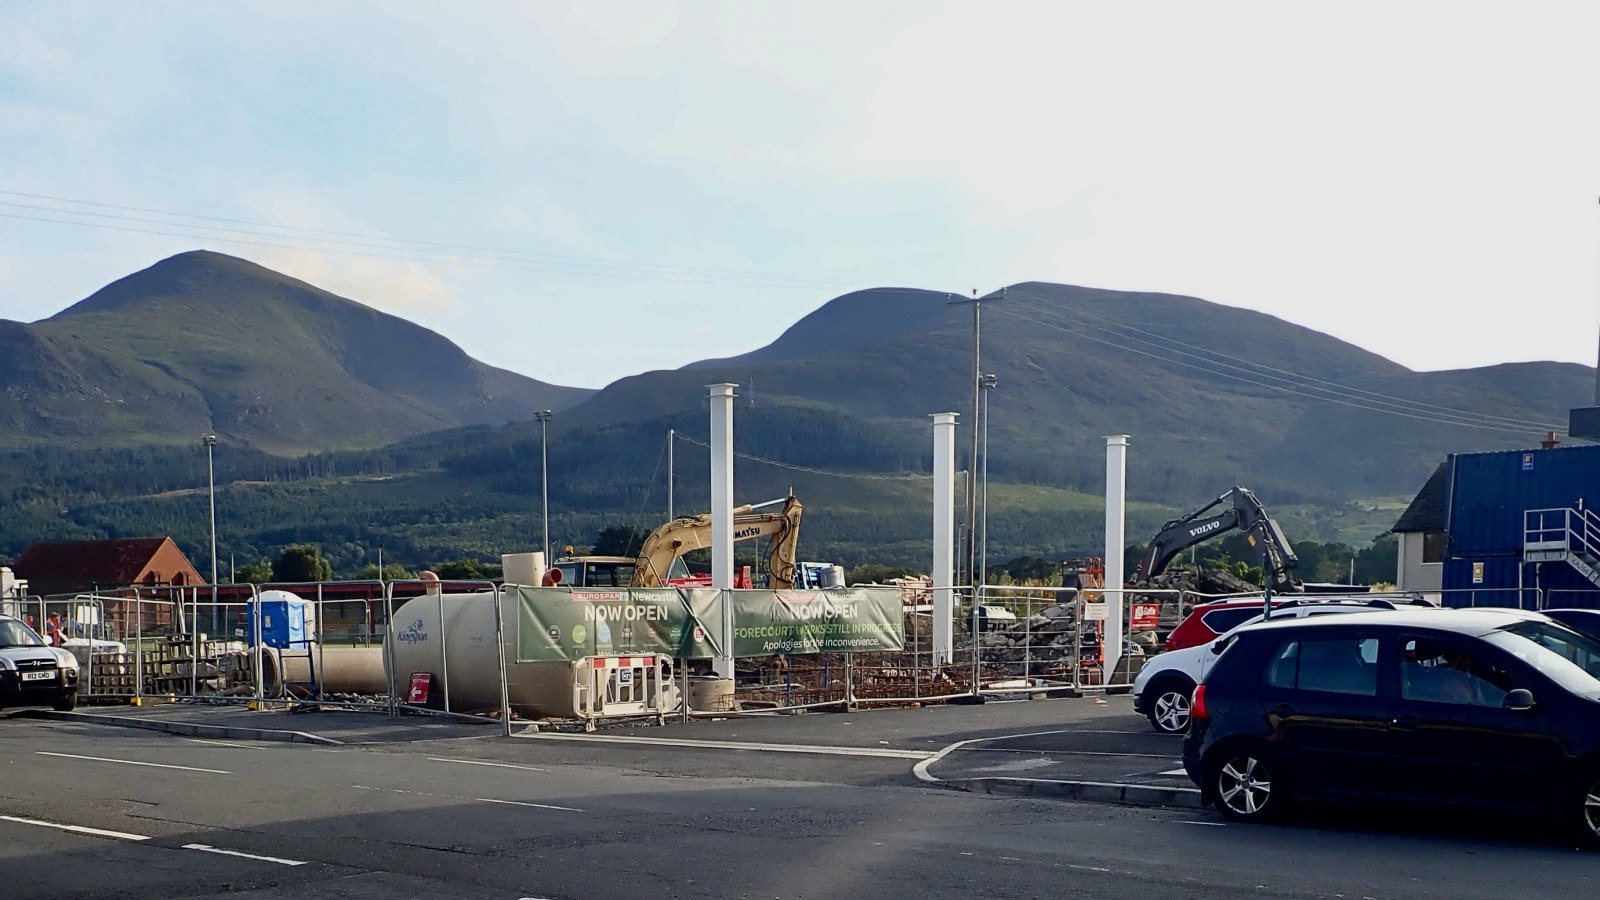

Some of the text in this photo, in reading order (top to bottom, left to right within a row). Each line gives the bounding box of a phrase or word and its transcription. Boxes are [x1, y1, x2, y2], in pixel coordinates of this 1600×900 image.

[733, 527, 760, 539] MATSU
[1190, 521, 1220, 536] VOLVO
[632, 592, 677, 602] Newcastle
[585, 605, 668, 621] NOW OPEN
[790, 604, 858, 620] NOW OPEN
[398, 631, 427, 644] Kingspan
[734, 625, 794, 639] FORECOURT
[826, 624, 851, 635] STILL
[852, 624, 861, 633] IN
[763, 639, 802, 651] Apologies
[825, 637, 880, 647] inconvenience.
